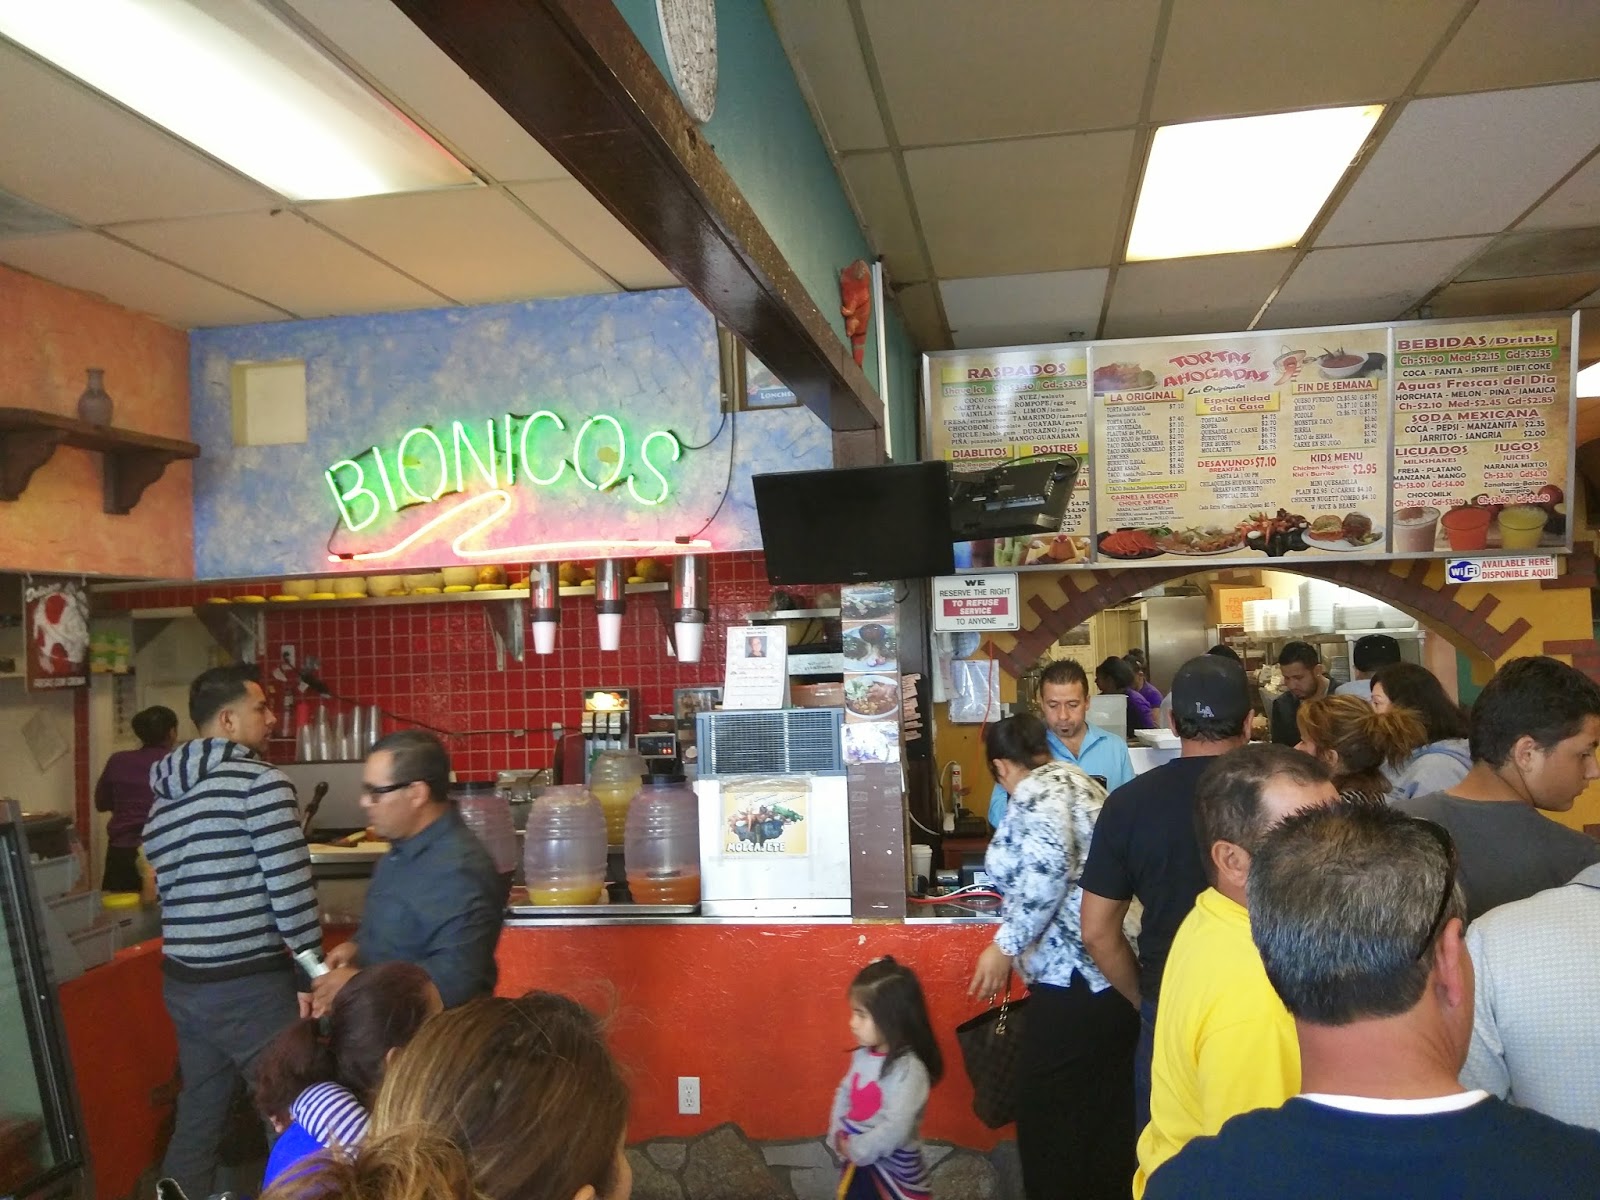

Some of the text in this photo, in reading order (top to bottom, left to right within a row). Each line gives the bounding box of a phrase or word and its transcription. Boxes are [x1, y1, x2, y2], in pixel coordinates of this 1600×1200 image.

[1169, 350, 1251, 368] TORTAS
[1401, 355, 1444, 365] Ch-$1.90
[1505, 350, 1551, 359] Gd-$2.35
[967, 363, 1066, 379] RASPADOS
[1434, 367, 1463, 376] FANTA
[1471, 365, 1499, 374] SPRITE
[1506, 364, 1526, 372] DIET
[1527, 363, 1551, 371] COKE
[1163, 368, 1270, 388] AHOGADAS
[1397, 375, 1556, 392] Aguas Frescas del Dia
[973, 385, 986, 393] Ice
[1297, 380, 1373, 392] FIN DE SEMANA
[1110, 391, 1177, 402] LA ORIGINAL
[1203, 394, 1271, 404] Especialidad
[1396, 387, 1556, 401] HORCHATA MELON PIÑA JAMAICA
[1399, 402, 1443, 410] Ch-$2.10
[1411, 409, 1539, 422] SODA MEXICANA
[1404, 420, 1546, 433] COCA PEPSI MANZANITA $2.35
[1419, 433, 1458, 442] JARRITOS
[1465, 431, 1502, 440] SANGRIA
[952, 444, 1078, 458] DIABLITOS POSTRES
[1395, 442, 1540, 456] LICUADOS JUGOS
[1197, 456, 1277, 468] DESAYUNOS $7.10
[1310, 452, 1363, 462] KIDS MENU
[324, 409, 681, 532] BIONICOS
[1352, 463, 1377, 475] $2.95
[1407, 491, 1452, 499] CHOCOMILK
[1481, 558, 1526, 569] AVAILABLE
[1528, 557, 1554, 566] HERE!
[1481, 568, 1554, 579] DISPONIBLE AQUI!
[939, 587, 1011, 597] RESERVE THE RIGHT
[966, 599, 999, 607] REFUSE
[959, 607, 992, 615] SERVICE
[956, 618, 965, 626] TO
[968, 617, 997, 626] ANYONE
[1195, 701, 1215, 718] LA
[726, 842, 786, 853] MOLCAJETE
